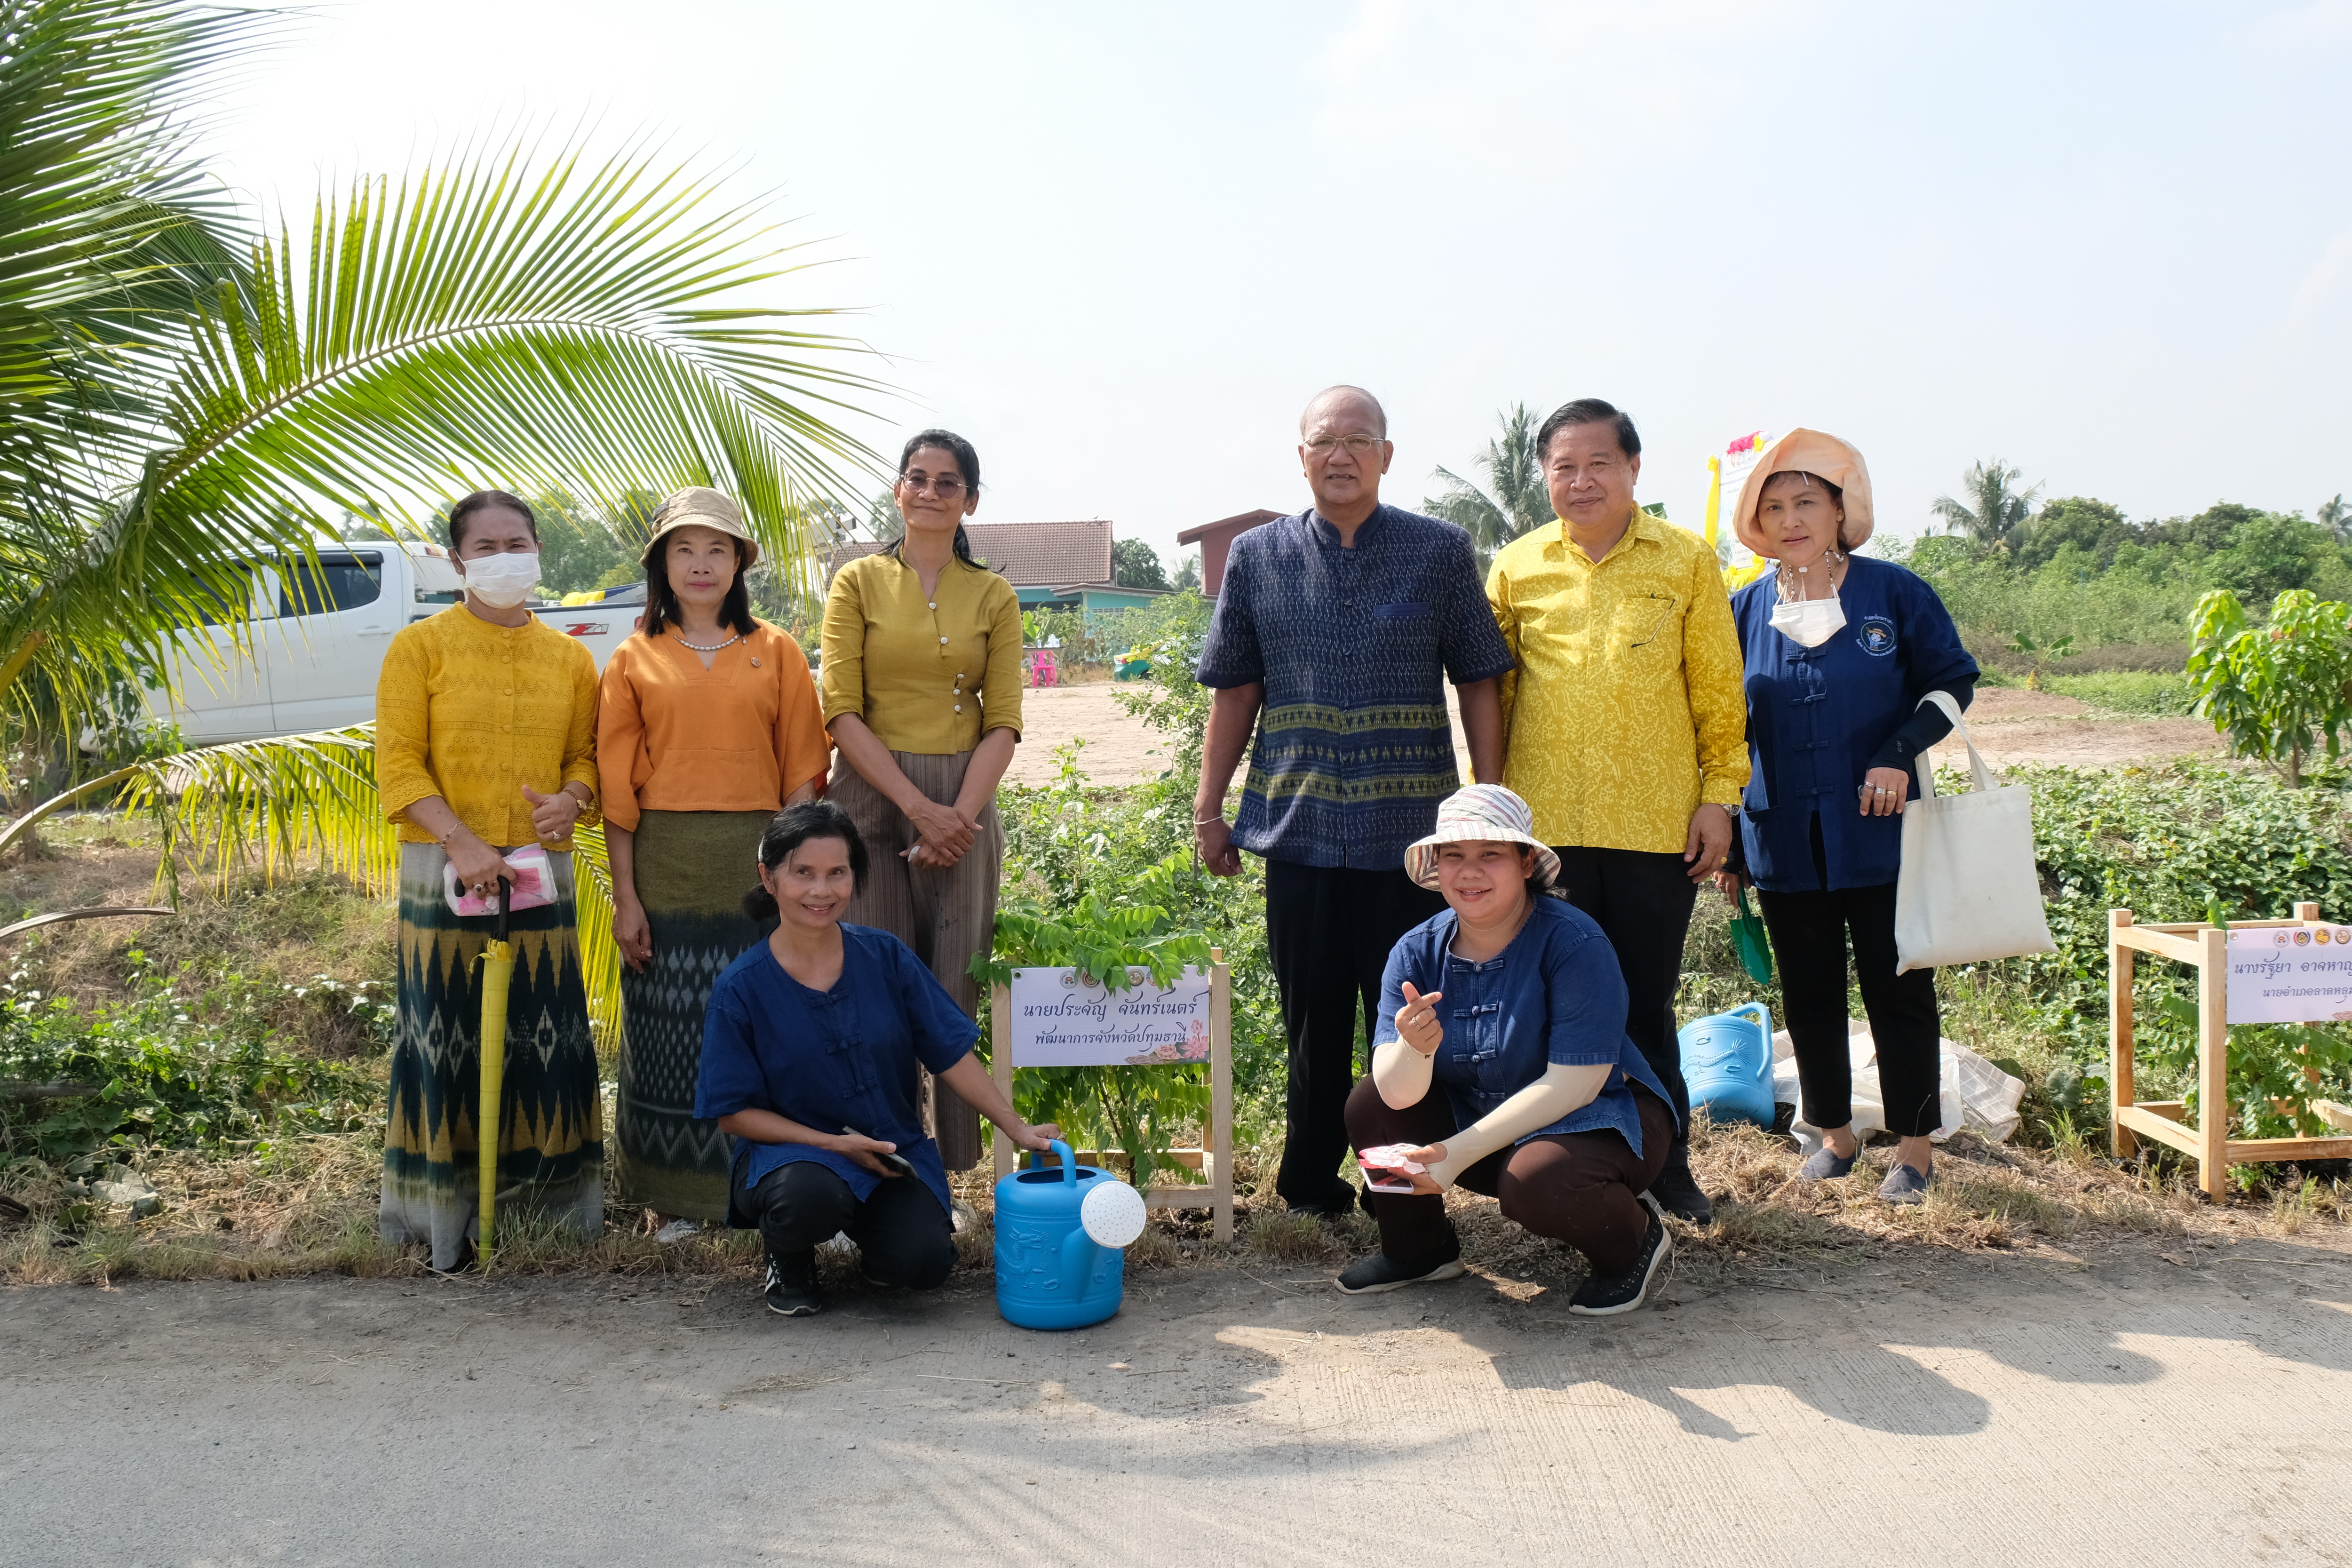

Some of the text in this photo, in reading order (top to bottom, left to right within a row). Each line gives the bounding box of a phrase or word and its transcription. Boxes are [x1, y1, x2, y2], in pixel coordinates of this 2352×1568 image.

[565, 623, 609, 637] Z71
[2234, 951, 2291, 979] นางรัฐยา
[1024, 991, 1107, 1022] นายประจัญ
[1035, 1021, 1187, 1052] พัฒนาการจังหวัดปทุมธานี
